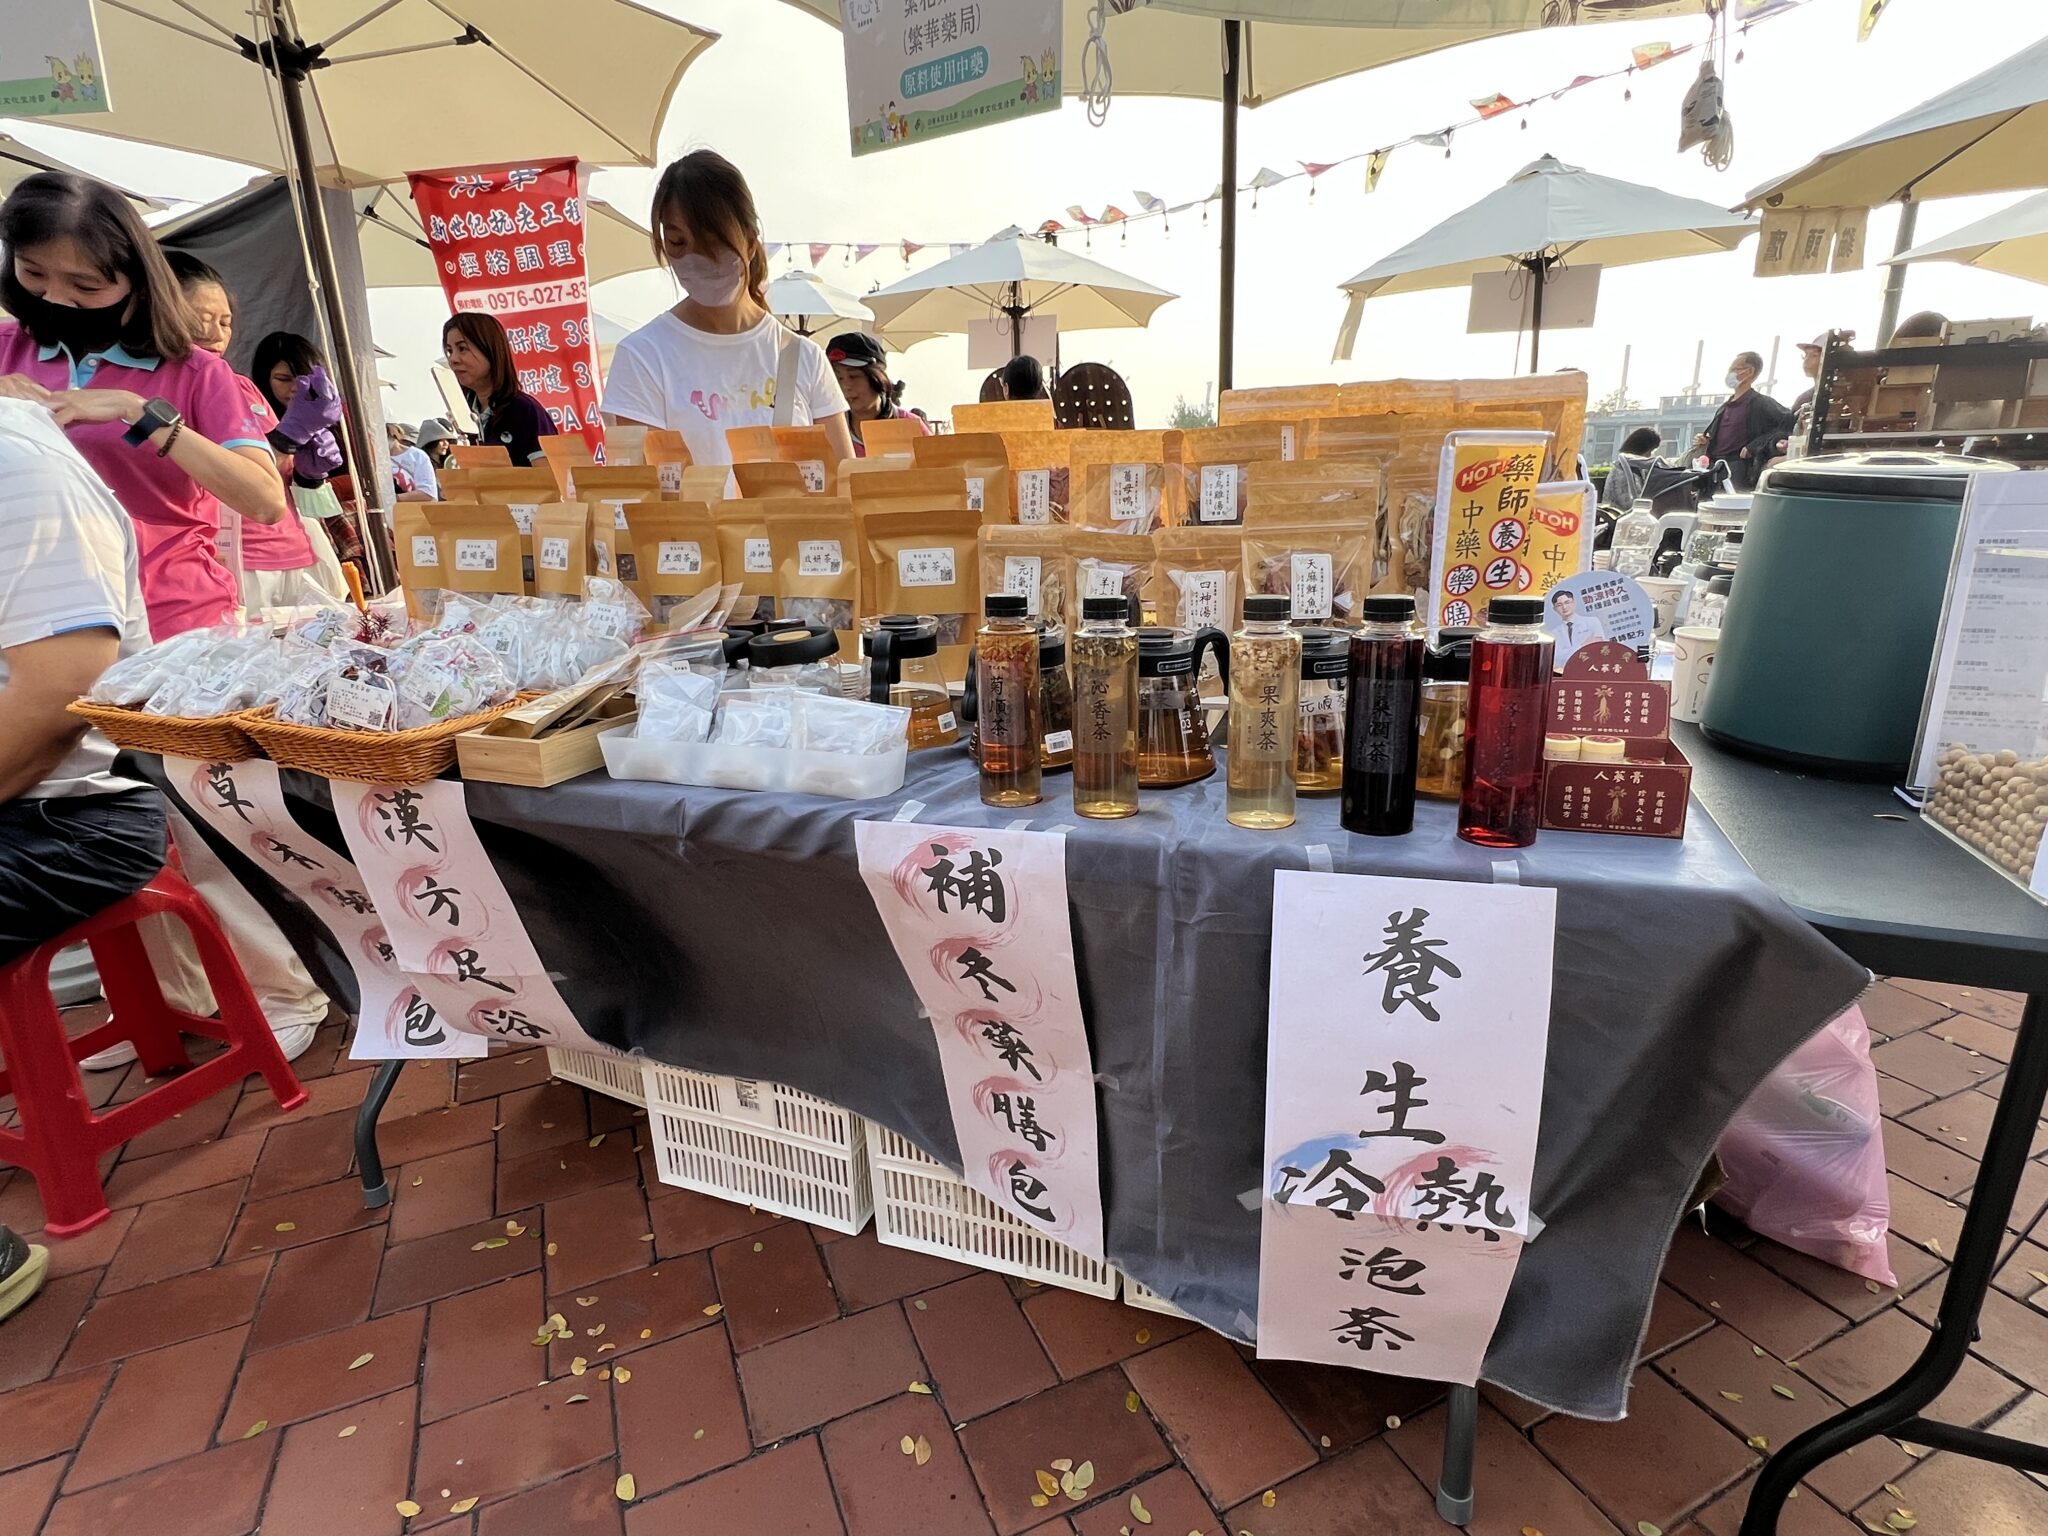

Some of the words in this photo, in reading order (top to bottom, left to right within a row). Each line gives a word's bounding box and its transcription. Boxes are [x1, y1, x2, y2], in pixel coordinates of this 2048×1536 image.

[903, 4, 981, 56] (繁華藥局)
[904, 51, 984, 95] 原料使用中藥
[459, 240, 574, 279] 經絡調理
[508, 322, 558, 354] 保健
[519, 366, 569, 393] 保健
[1460, 460, 1508, 488] HOT!
[1199, 581, 1212, 618] 四神湯
[1305, 558, 1318, 609] 天麻鮮魚
[990, 675, 1009, 736] 菊順茶
[1090, 680, 1113, 741] 沁香茶
[1256, 685, 1280, 751] 果爽茶
[920, 843, 1057, 1223] 補冬藥膳包
[1362, 907, 1463, 1146] 養生
[1273, 1148, 1516, 1243] 冷熱
[1329, 1246, 1428, 1353] 泡茶
